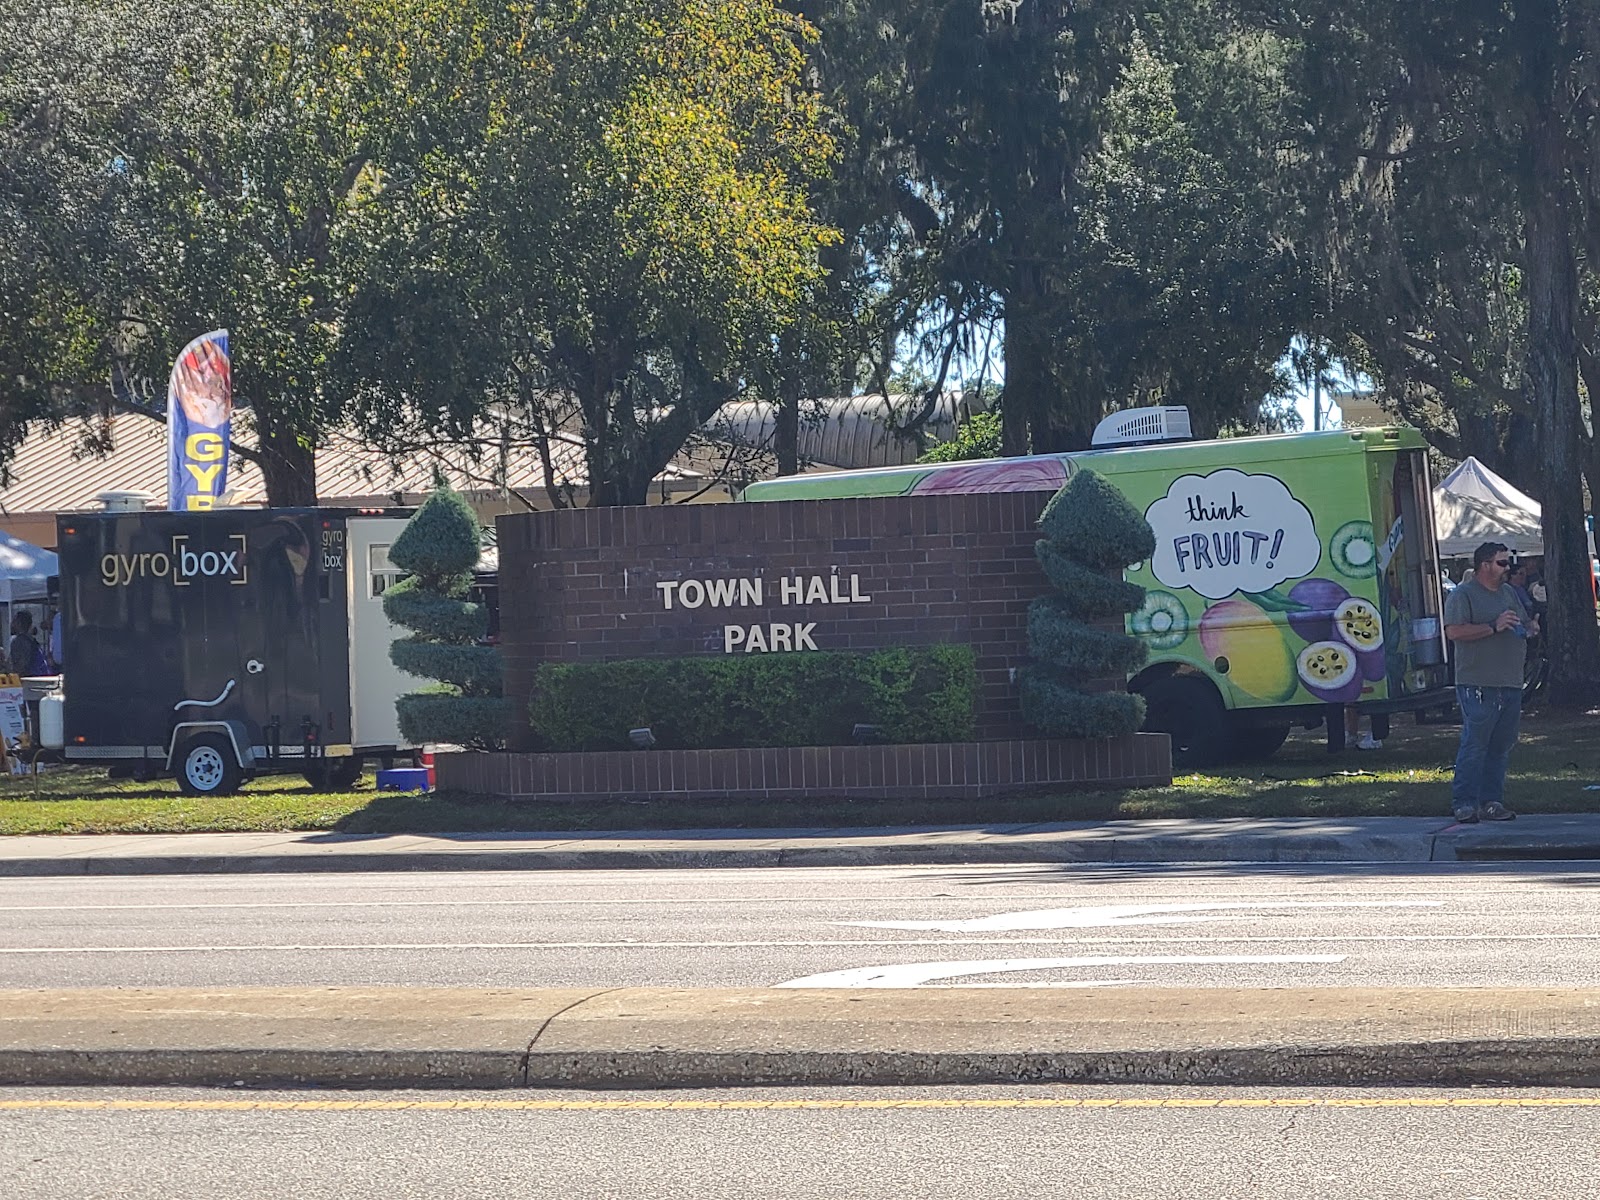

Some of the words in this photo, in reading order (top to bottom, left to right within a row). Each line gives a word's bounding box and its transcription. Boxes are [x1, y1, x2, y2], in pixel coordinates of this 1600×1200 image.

[1184, 491, 1251, 523] think
[322, 530, 343, 547] gyro
[1173, 528, 1285, 573] FRUIT!
[101, 551, 170, 586] gyro
[656, 577, 763, 610] TOWN
[780, 574, 872, 606] HALL
[724, 622, 819, 654] PARK
